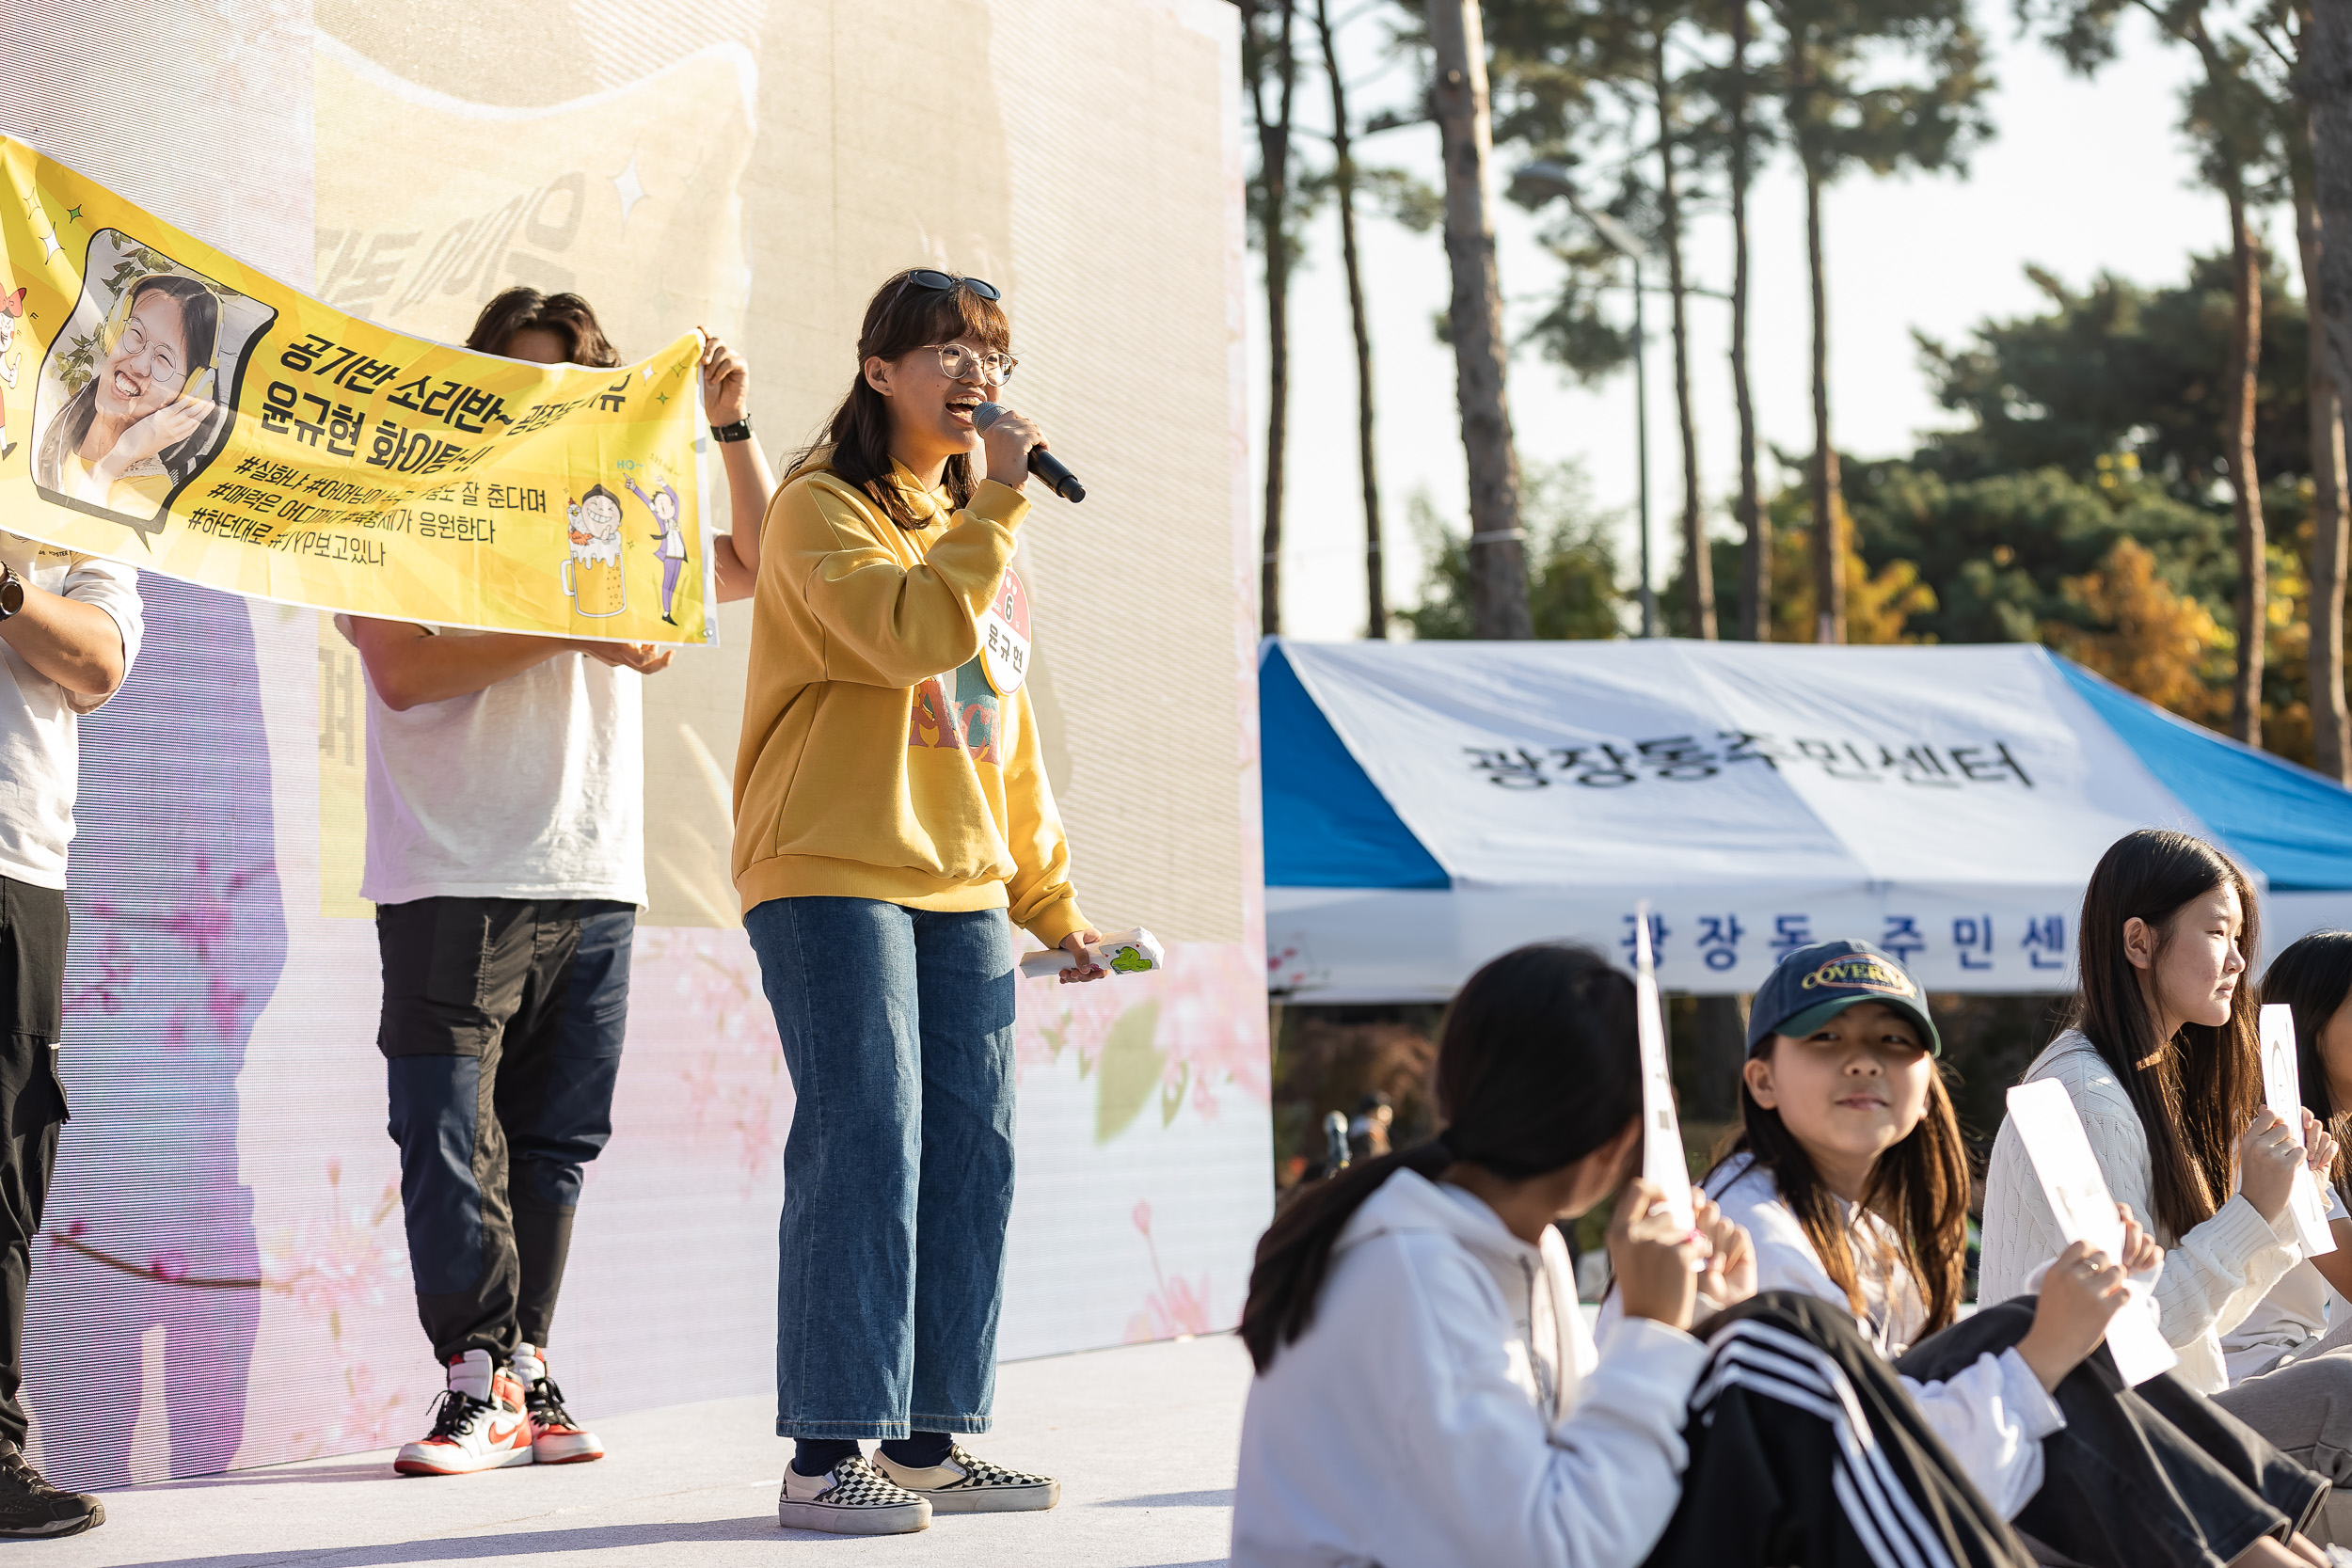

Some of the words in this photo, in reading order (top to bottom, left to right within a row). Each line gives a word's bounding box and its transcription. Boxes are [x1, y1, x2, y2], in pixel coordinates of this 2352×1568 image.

[280, 334, 400, 394] 공기반
[387, 375, 516, 434] 소리반~
[261, 381, 366, 457] 윤규현
[207, 482, 282, 513] #매력은
[420, 511, 496, 544] 응원한다
[233, 456, 310, 490] #실화냐
[302, 478, 386, 504] #어머님이
[462, 482, 480, 506] 잘
[487, 483, 547, 513] 춘다며
[187, 507, 274, 546] #하던대로
[268, 531, 386, 566] #JYP보고있나
[1005, 595, 1013, 620] 6
[988, 623, 1024, 673] 윤규현
[1462, 729, 2035, 790] 광장동주민센터
[1620, 912, 1817, 972] 광장동
[1880, 913, 2065, 971] 주민센
